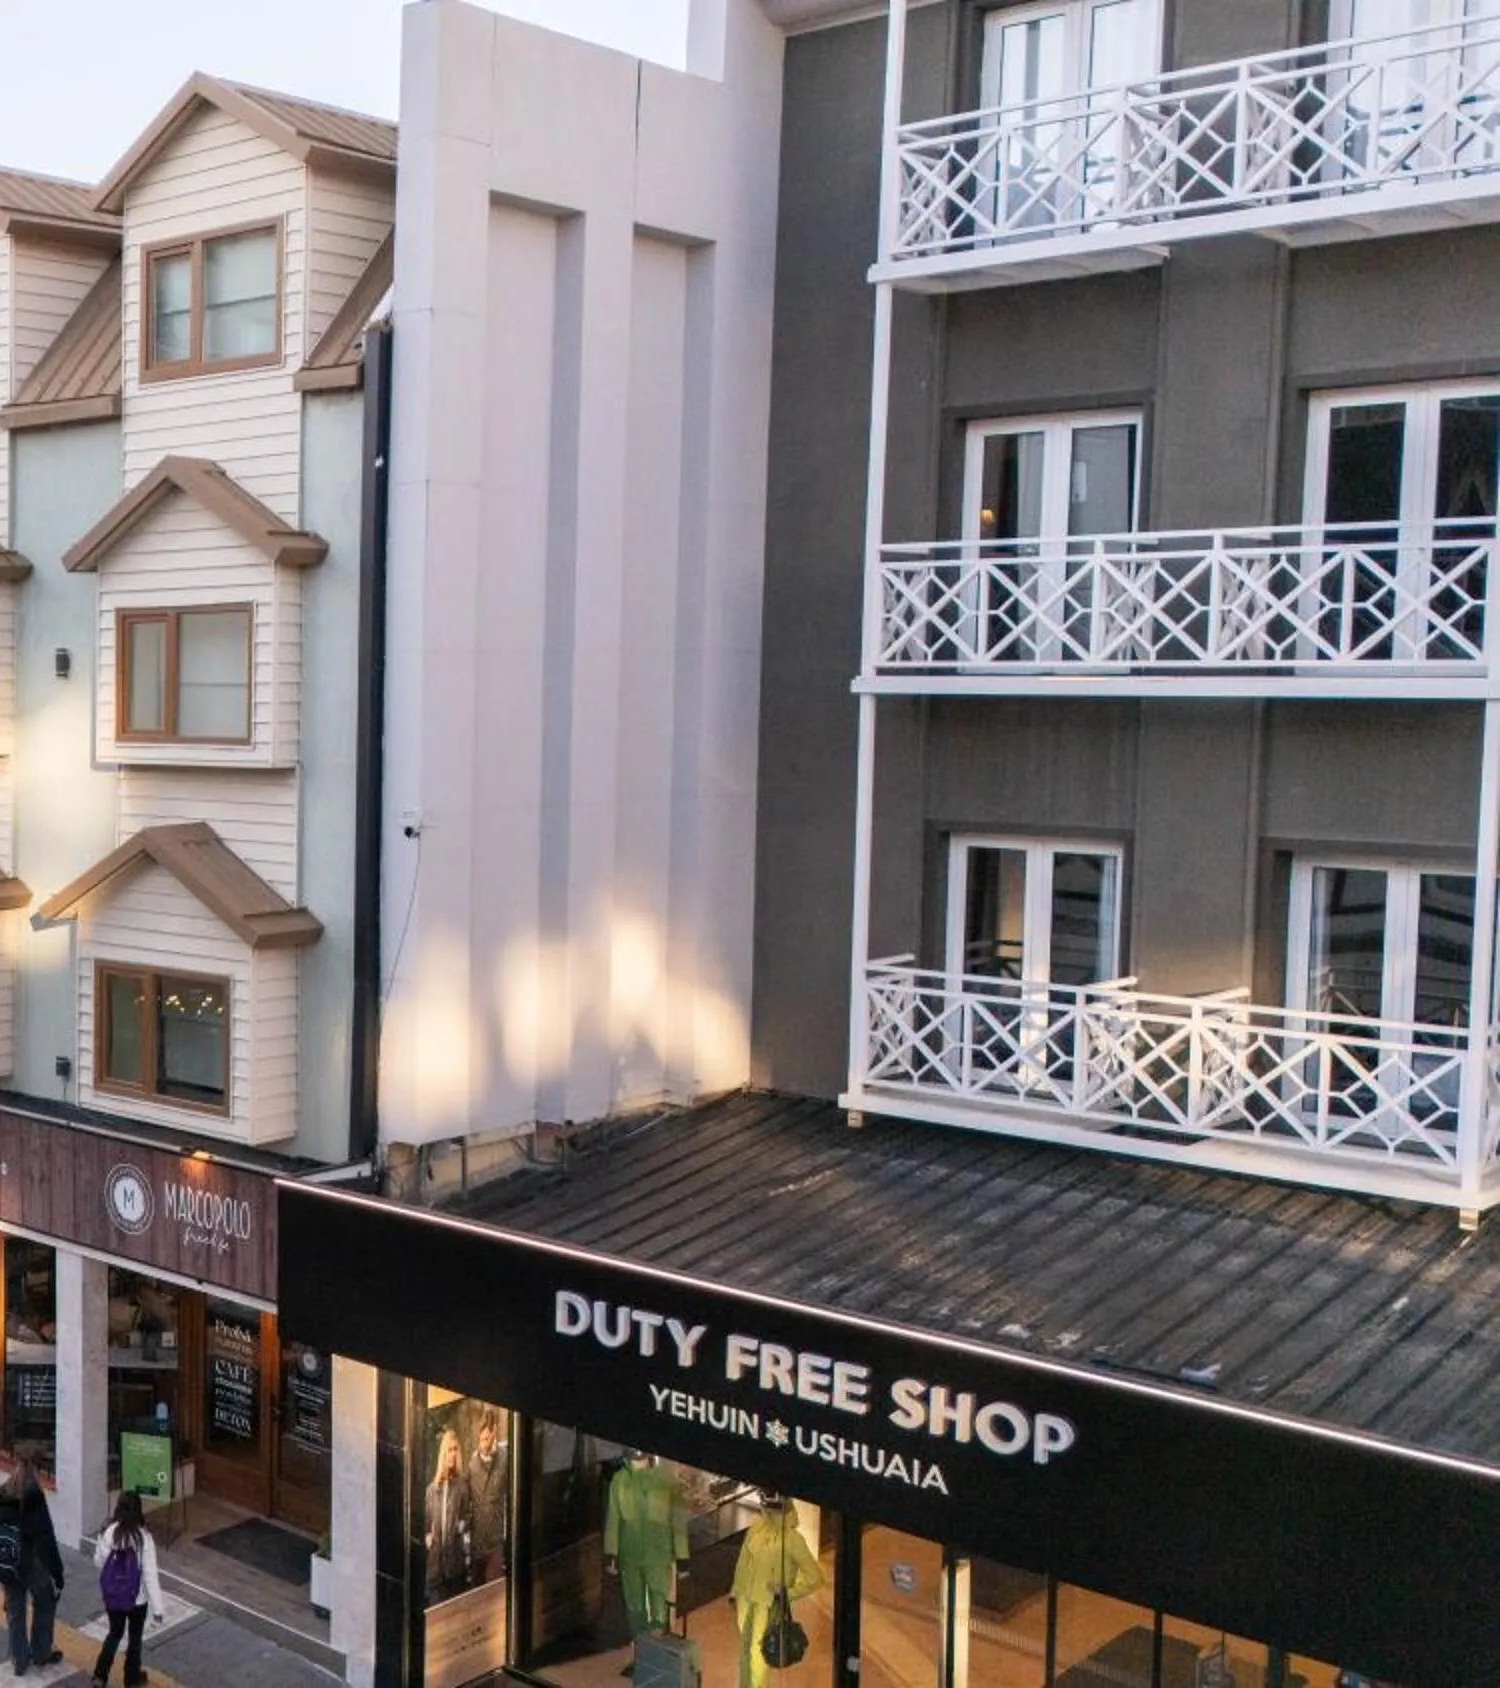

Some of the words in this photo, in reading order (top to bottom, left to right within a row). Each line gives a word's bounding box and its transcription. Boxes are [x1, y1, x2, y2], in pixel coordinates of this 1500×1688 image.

[164, 1181, 250, 1239] MARCOPOLO
[554, 1290, 707, 1368] DUTY
[725, 1334, 873, 1416] FREE
[888, 1378, 1078, 1465] SHOP
[650, 1385, 760, 1440] YEHUIN
[796, 1426, 949, 1496] USHUAIA
